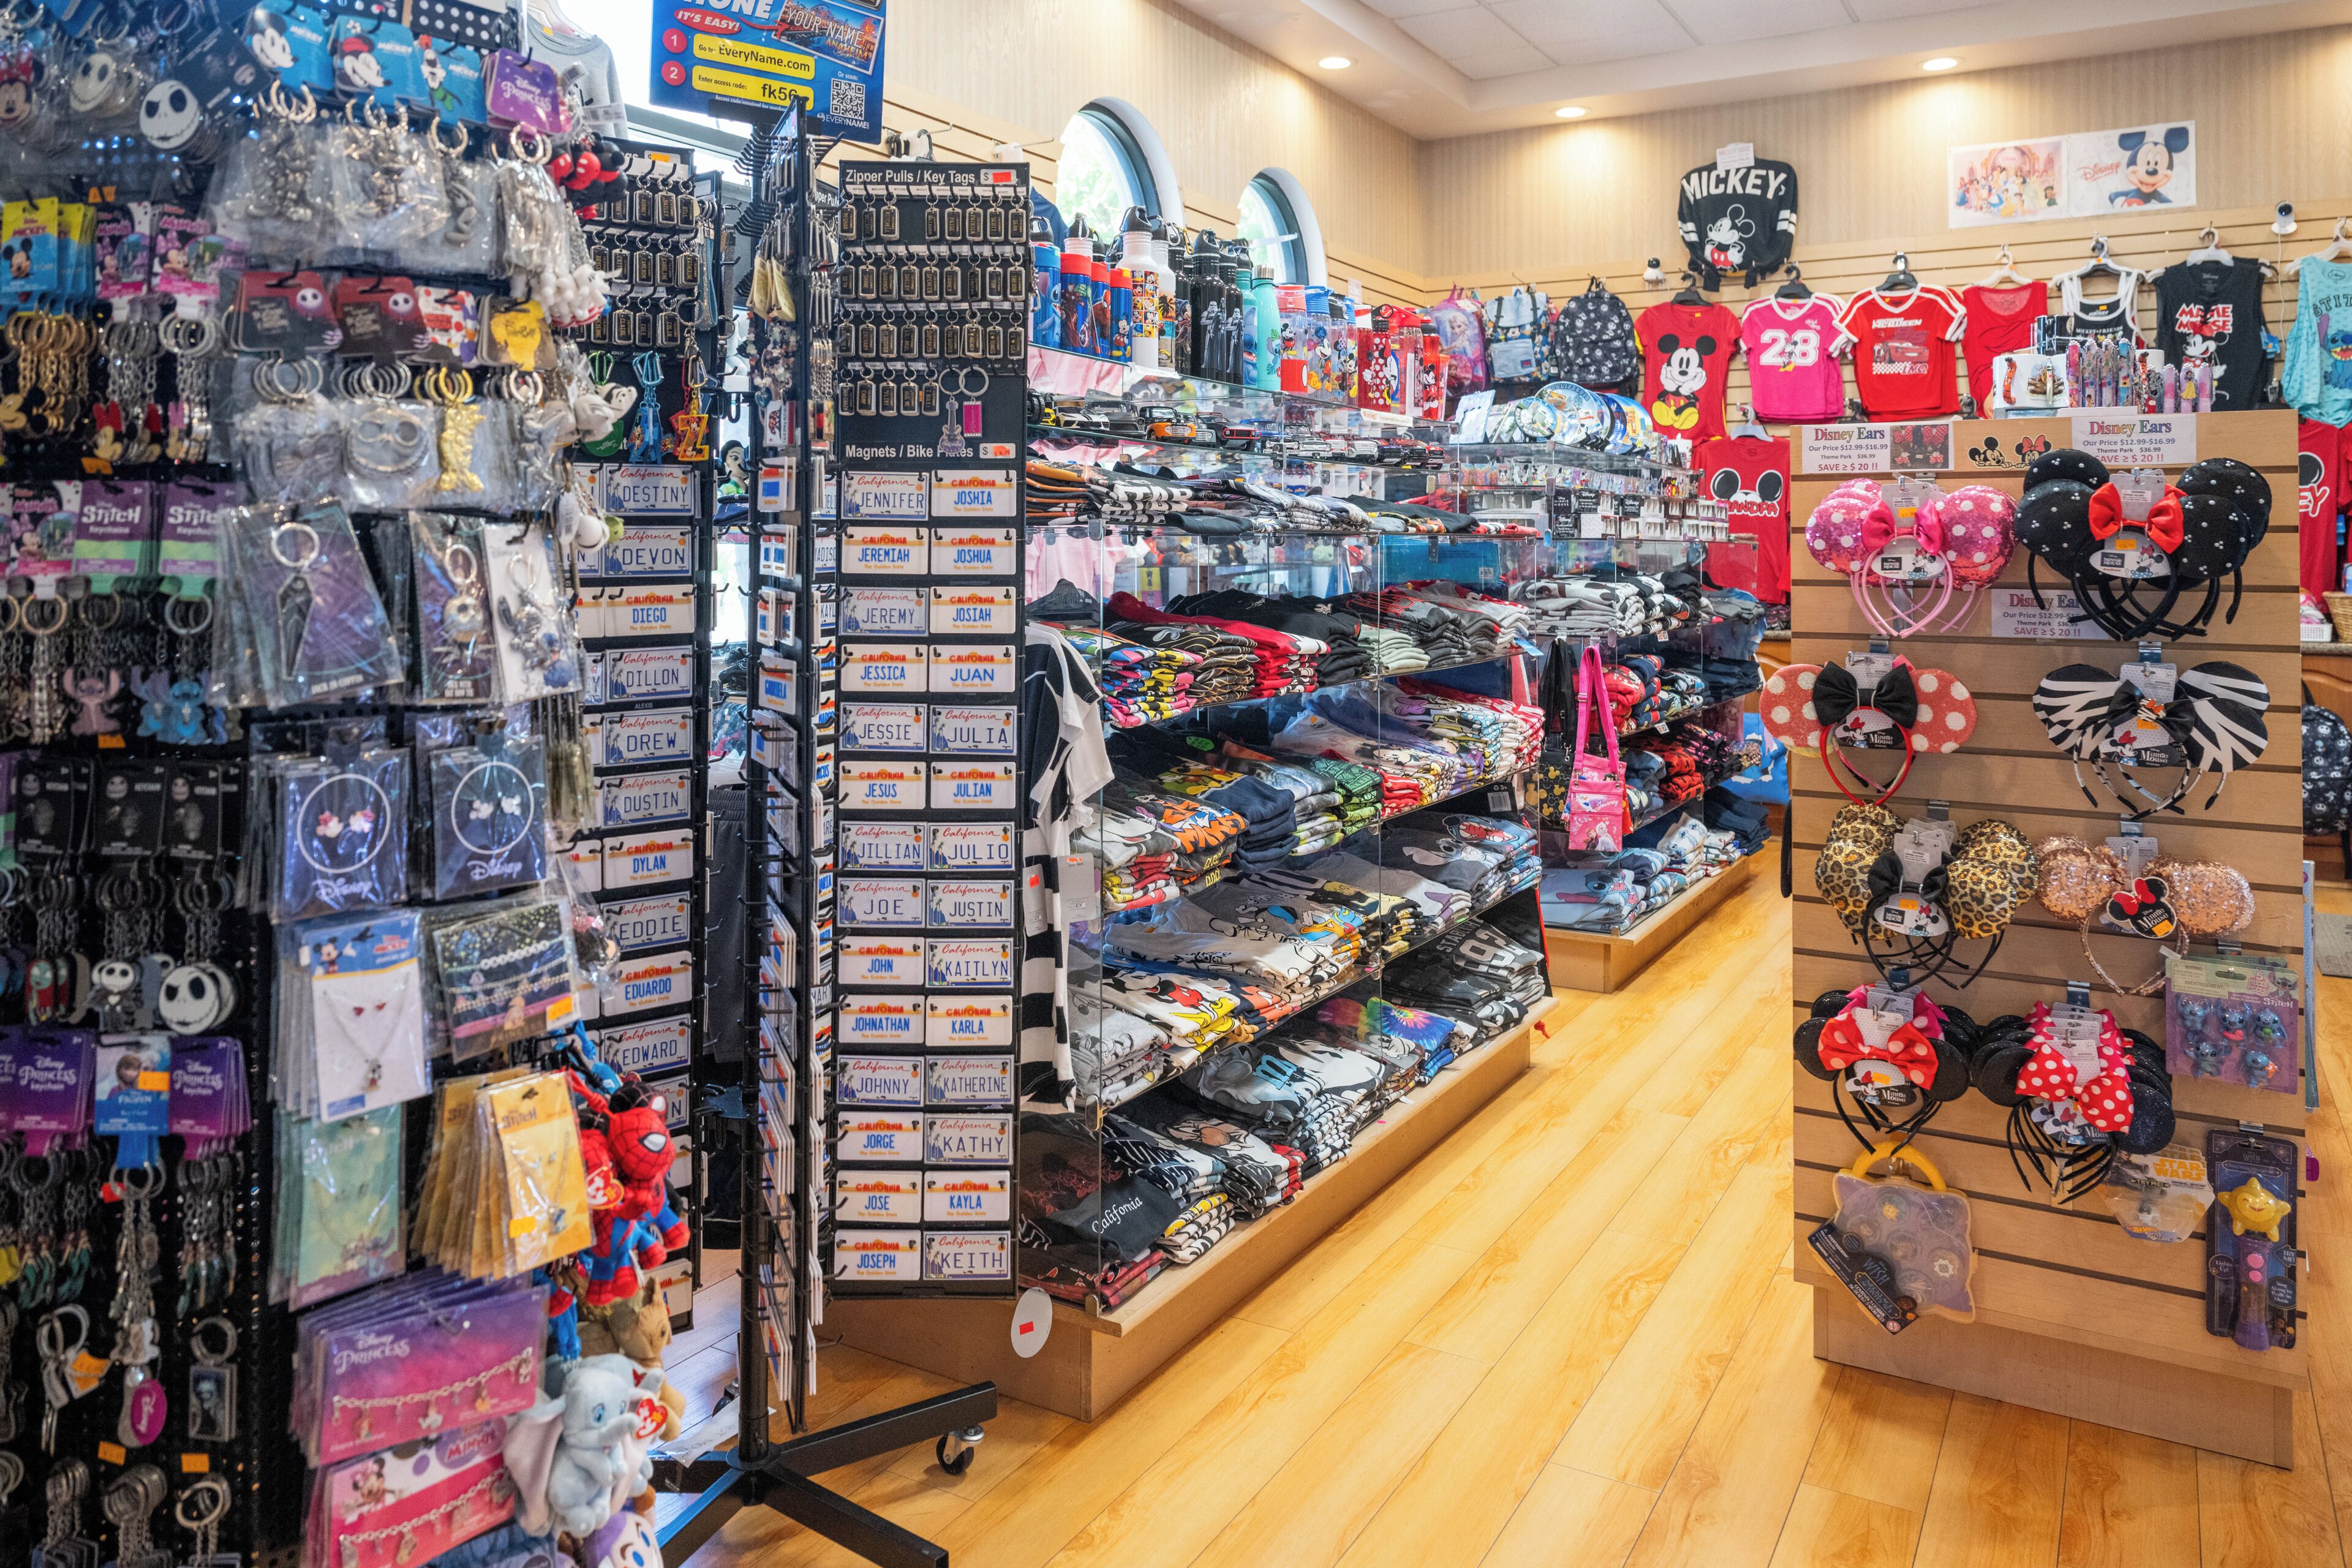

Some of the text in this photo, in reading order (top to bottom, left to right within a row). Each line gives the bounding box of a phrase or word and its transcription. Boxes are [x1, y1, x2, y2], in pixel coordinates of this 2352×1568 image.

[677, 10, 740, 31] IT'S EASY!
[788, 9, 821, 32] YOUR
[825, 22, 865, 48] NAME
[671, 34, 677, 46] 1
[826, 39, 868, 59] ANAHEIM
[719, 46, 810, 72] EveryName.com
[670, 67, 677, 79] 2
[513, 74, 540, 94] Disney
[698, 75, 712, 84] Enter
[714, 78, 730, 88] access
[732, 81, 747, 90] code:
[501, 81, 551, 111] PRINCESS
[846, 170, 883, 184] Zipper
[886, 170, 913, 183] Pulls
[924, 171, 945, 184] Key
[949, 171, 975, 184] Tags
[983, 172, 989, 182] $
[2077, 160, 2121, 182] Disney
[1681, 168, 1787, 205] MICKEY
[1760, 330, 1820, 366] 28
[1550, 383, 1590, 402] CALIFORNIA
[1814, 427, 1885, 443] Disney Ears
[2089, 420, 2172, 438] Disney Ears
[982, 444, 989, 456] $
[2120, 438, 2175, 447] $12.99-$16.99
[846, 445, 897, 460] Magnets
[907, 445, 933, 458] Bike
[2132, 454, 2138, 463] $
[620, 468, 679, 480] California
[1818, 463, 1840, 472] SAVE
[1850, 462, 1855, 471] $
[858, 475, 914, 488] California
[623, 486, 687, 503] DESTINY
[858, 492, 924, 508] JENNIFER
[954, 491, 992, 505] JOSHIA
[622, 548, 685, 565] DEVON
[858, 548, 910, 562] JEREMIAH
[954, 549, 992, 563] JOSHUA
[626, 595, 674, 604] CALIFORNIA
[2009, 594, 2054, 611] Disny
[633, 608, 666, 624] DIEGO
[862, 608, 915, 624] JEREMY
[952, 607, 991, 622] JOSIAH
[949, 655, 995, 663] CALIFORNIA
[627, 668, 679, 687] DILLON
[861, 666, 905, 680] JESSICA
[951, 668, 995, 682] JUAN
[856, 707, 913, 717] California
[945, 709, 1003, 720] California
[620, 718, 678, 730] California
[859, 723, 911, 741] JESSIE
[948, 727, 1008, 744] JULIA
[627, 732, 676, 752] DREW
[865, 783, 897, 797] JESUS
[953, 783, 992, 797] JULIAN
[624, 791, 678, 813] DUSTIN
[1596, 798, 1620, 810] Journey
[943, 827, 1000, 838] California
[858, 843, 921, 859] JILLIAN
[948, 843, 1009, 860] JULIO
[467, 859, 522, 881] Disney
[633, 855, 666, 873] DYLAN
[942, 884, 999, 895] California
[864, 899, 904, 916] JOE
[949, 901, 1003, 917] JUSTIN
[619, 915, 682, 940] EDDIE
[942, 944, 1000, 954] California
[867, 959, 893, 973] JOHN
[945, 960, 1008, 976] KAITLYN
[625, 978, 671, 1000] EDUARDO
[2184, 981, 2225, 990] AVERTISSEMENT:
[2263, 997, 2293, 1008] STITCH
[851, 1017, 910, 1032] JOHNATHAN
[952, 1020, 984, 1034] KARLA
[622, 1039, 677, 1066] EDWARD
[19, 1066, 77, 1085] PRINCESS
[173, 1069, 223, 1090] PRINCESS
[856, 1077, 910, 1095] JOHNNY
[943, 1076, 1007, 1093] KATHERINE
[940, 1120, 997, 1130] California
[863, 1134, 895, 1149] JORGE
[943, 1136, 1004, 1153] KATHY
[2152, 1158, 2201, 1172] STAR
[2244, 1153, 2260, 1164] WISH
[2155, 1167, 2203, 1181] WARS
[865, 1196, 890, 1210] JOSE
[949, 1195, 982, 1210] KAYLA
[1092, 1196, 1143, 1234] California
[939, 1236, 996, 1248] California
[857, 1254, 895, 1268] JOSEPH
[940, 1252, 1003, 1268] KEITH
[1863, 1257, 1890, 1285] WISH
[333, 1338, 410, 1375] PRINCESS
